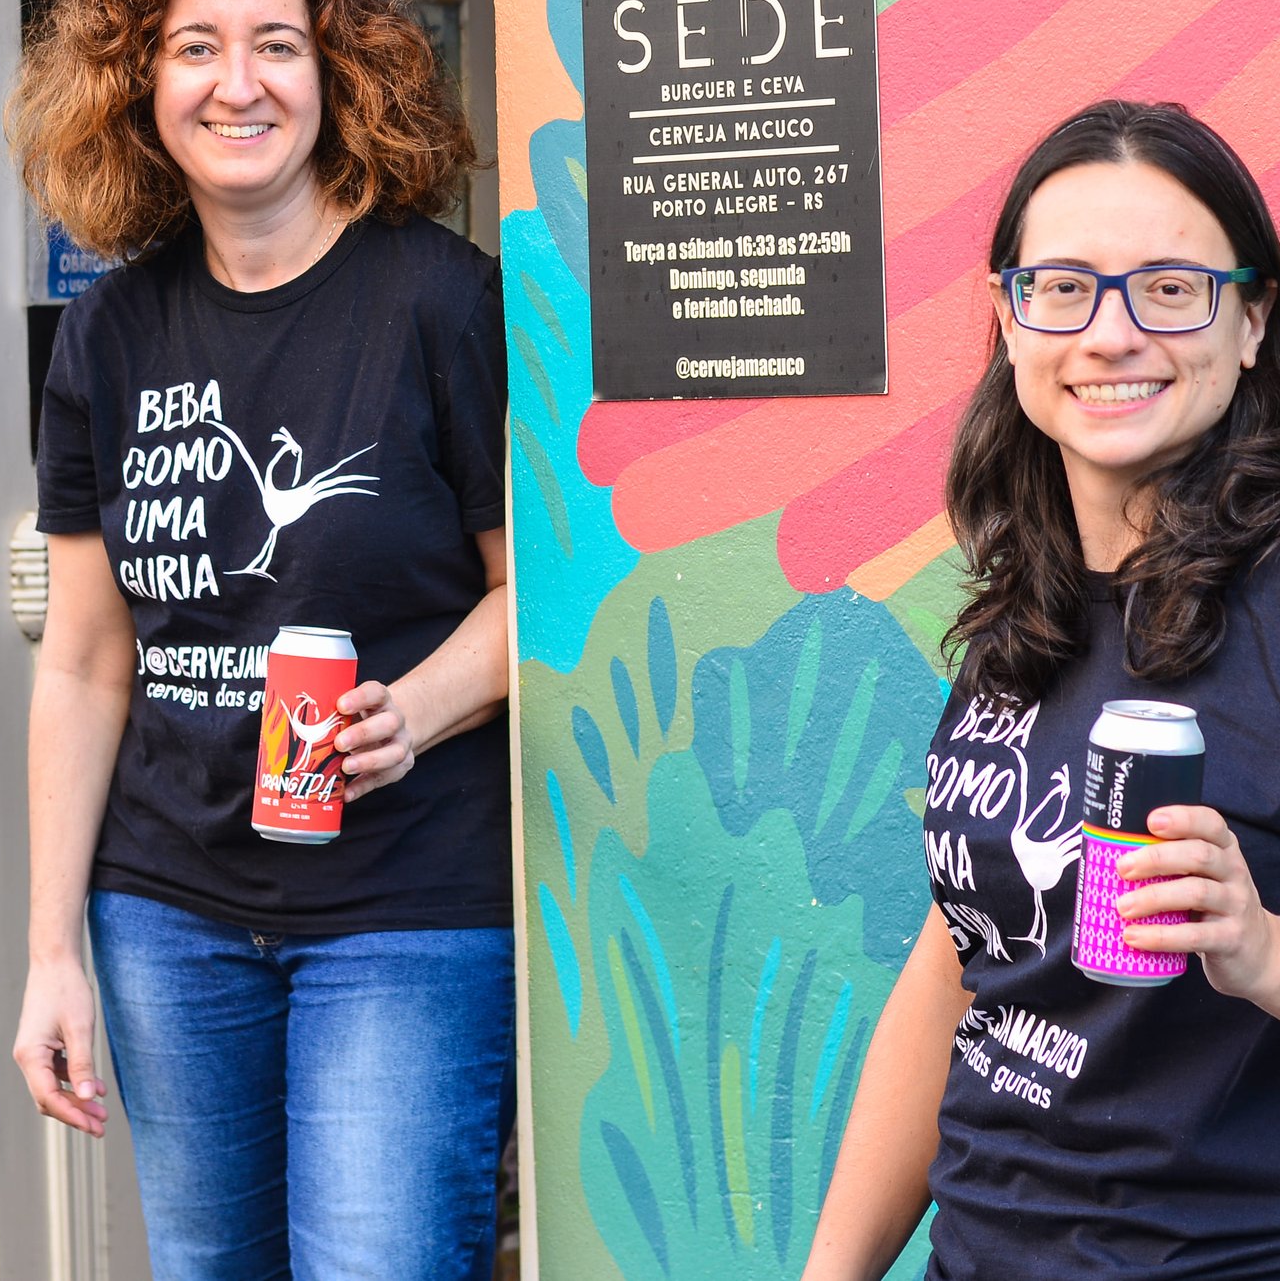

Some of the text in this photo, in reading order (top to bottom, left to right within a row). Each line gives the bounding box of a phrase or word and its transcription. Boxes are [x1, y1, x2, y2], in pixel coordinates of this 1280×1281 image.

[661, 75, 805, 102] BURGUER E CEVA
[649, 118, 814, 146] CERVEJA MACUCO
[622, 175, 655, 195] RUA
[663, 170, 744, 193] GENERAL
[814, 164, 849, 185] 267
[652, 199, 706, 218] PORTO
[714, 194, 778, 215] ALEGRE
[804, 191, 823, 210] RS
[624, 231, 851, 265] Terça a sábado 16:33 as 22:59h
[670, 264, 806, 291] Domingo, segunda
[672, 293, 805, 319] e feriado fechado.
[676, 355, 805, 380] @cervejamacuco
[137, 379, 222, 434] BEBA
[122, 437, 232, 490] COMO
[125, 496, 207, 544] UMA
[120, 553, 220, 602] GURIA
[145, 645, 269, 679] @CERVEJAM
[146, 682, 209, 711] cerveja
[215, 683, 245, 707] das
[950, 692, 1040, 750] BEBA
[1110, 772, 1126, 829] MACUCO
[925, 830, 977, 892] MA
[991, 1065, 1052, 1109] gurias
